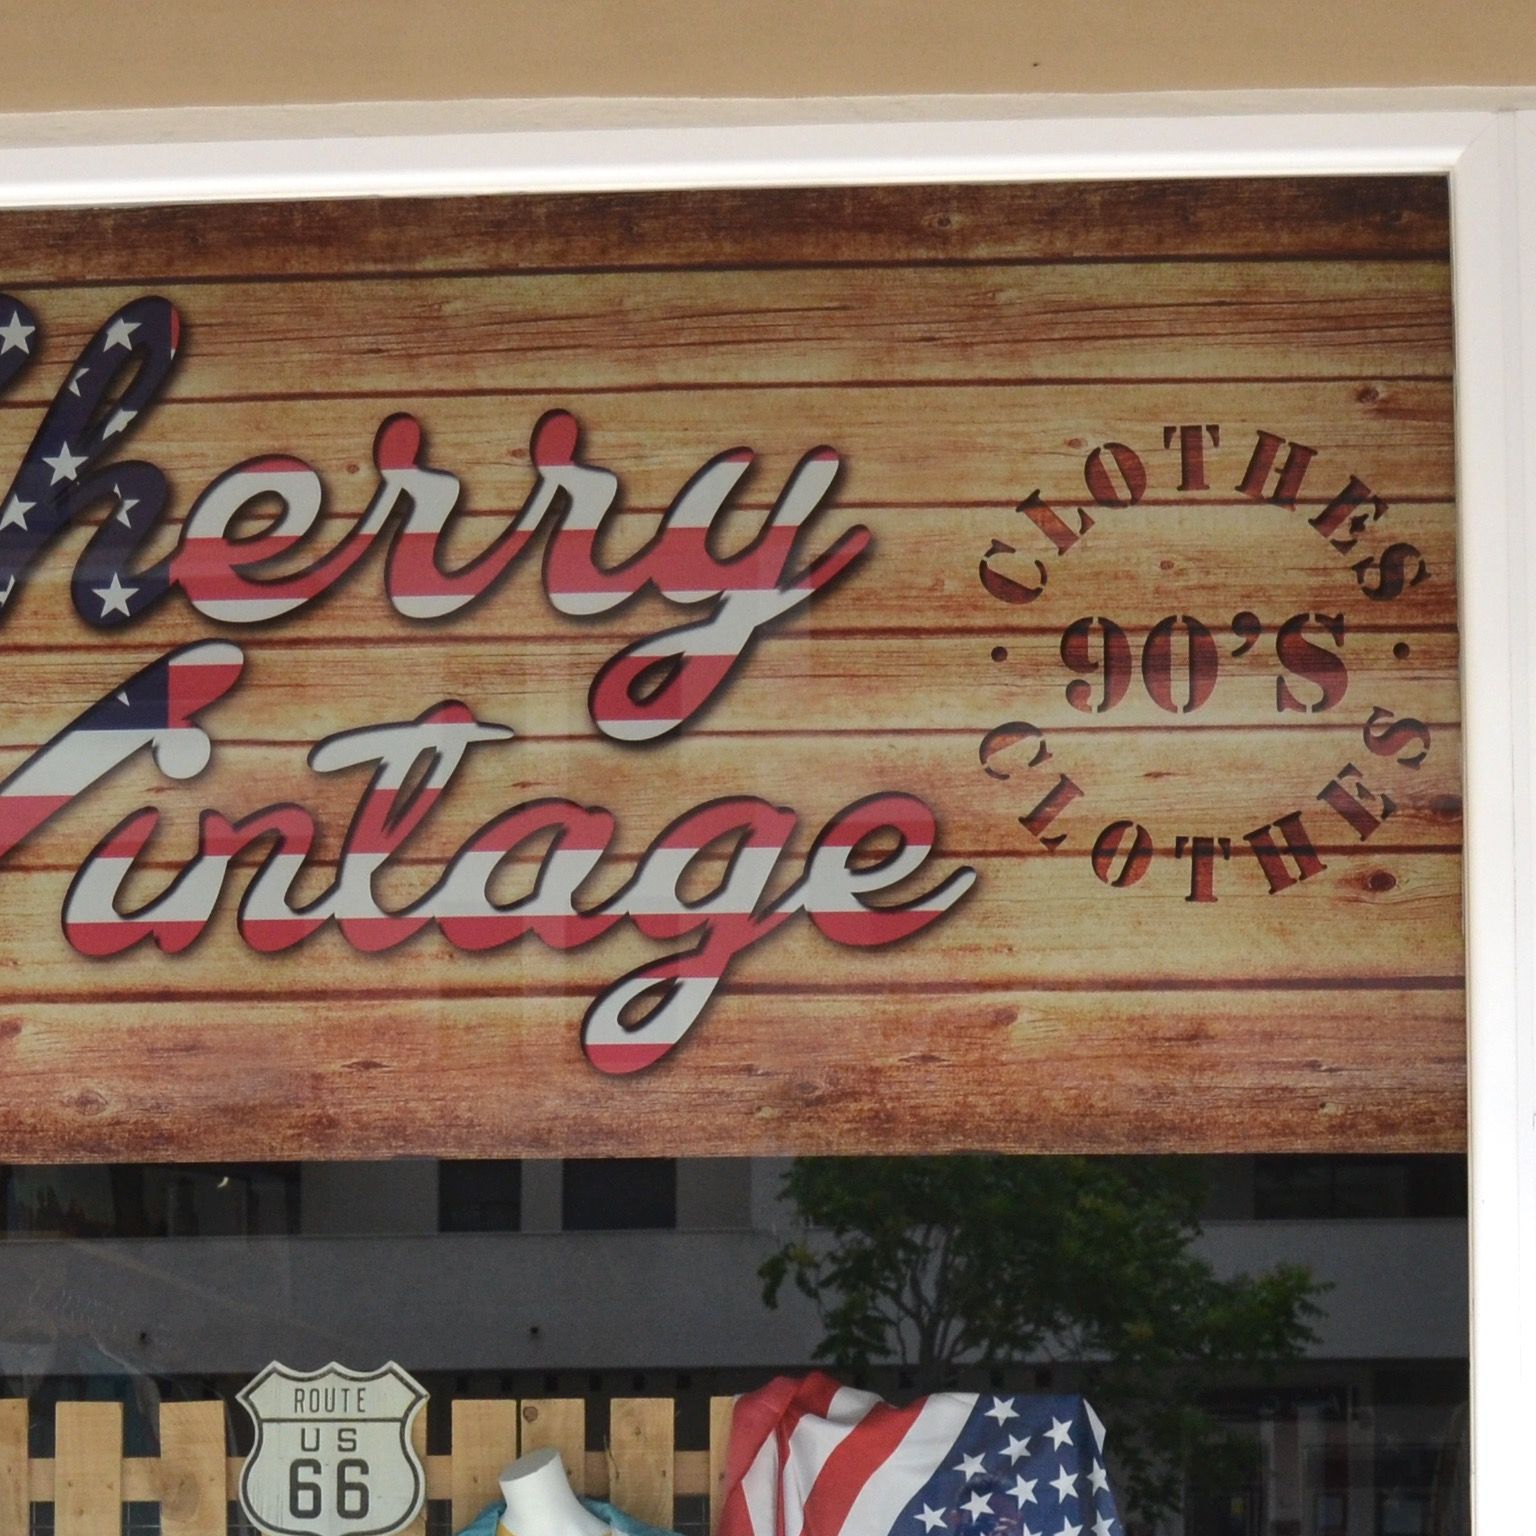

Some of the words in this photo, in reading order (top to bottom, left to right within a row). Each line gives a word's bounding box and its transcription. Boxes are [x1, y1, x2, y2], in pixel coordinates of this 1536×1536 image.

[979, 424, 1432, 604] CLOTHES
[1060, 611, 1349, 714] 90'S
[979, 706, 1432, 902] CLOTHES
[294, 1387, 366, 1413] ROUTE
[289, 1458, 369, 1519] 66
